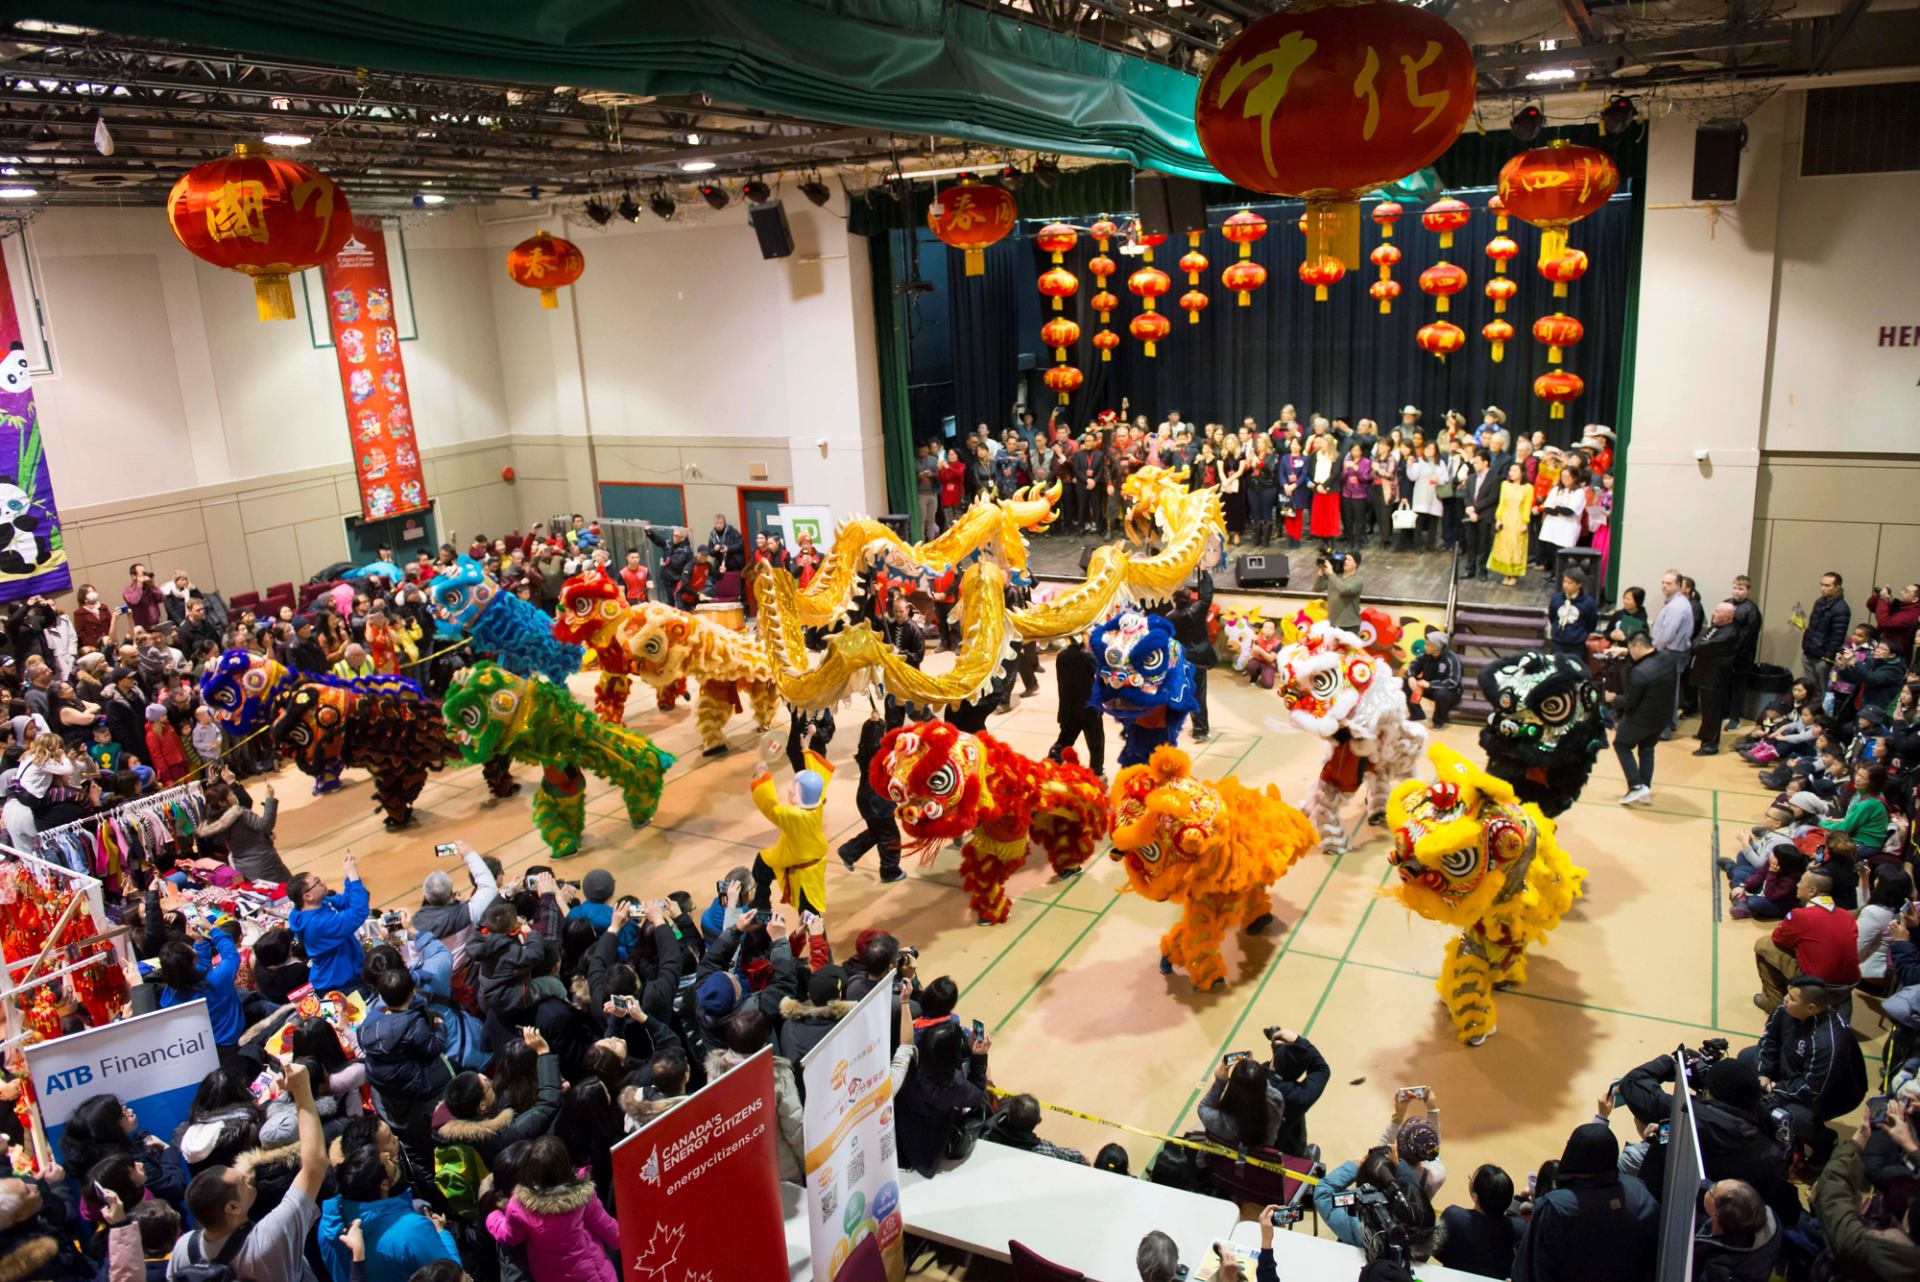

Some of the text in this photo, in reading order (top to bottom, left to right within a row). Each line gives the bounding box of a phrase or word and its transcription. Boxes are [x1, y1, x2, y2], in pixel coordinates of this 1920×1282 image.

[45, 1032, 206, 1096] ATB Financial
[662, 1113, 723, 1160] CANADA'S
[663, 1097, 764, 1173] ENERGY CITIZENS
[666, 1122, 766, 1196] energycitizens.ca
